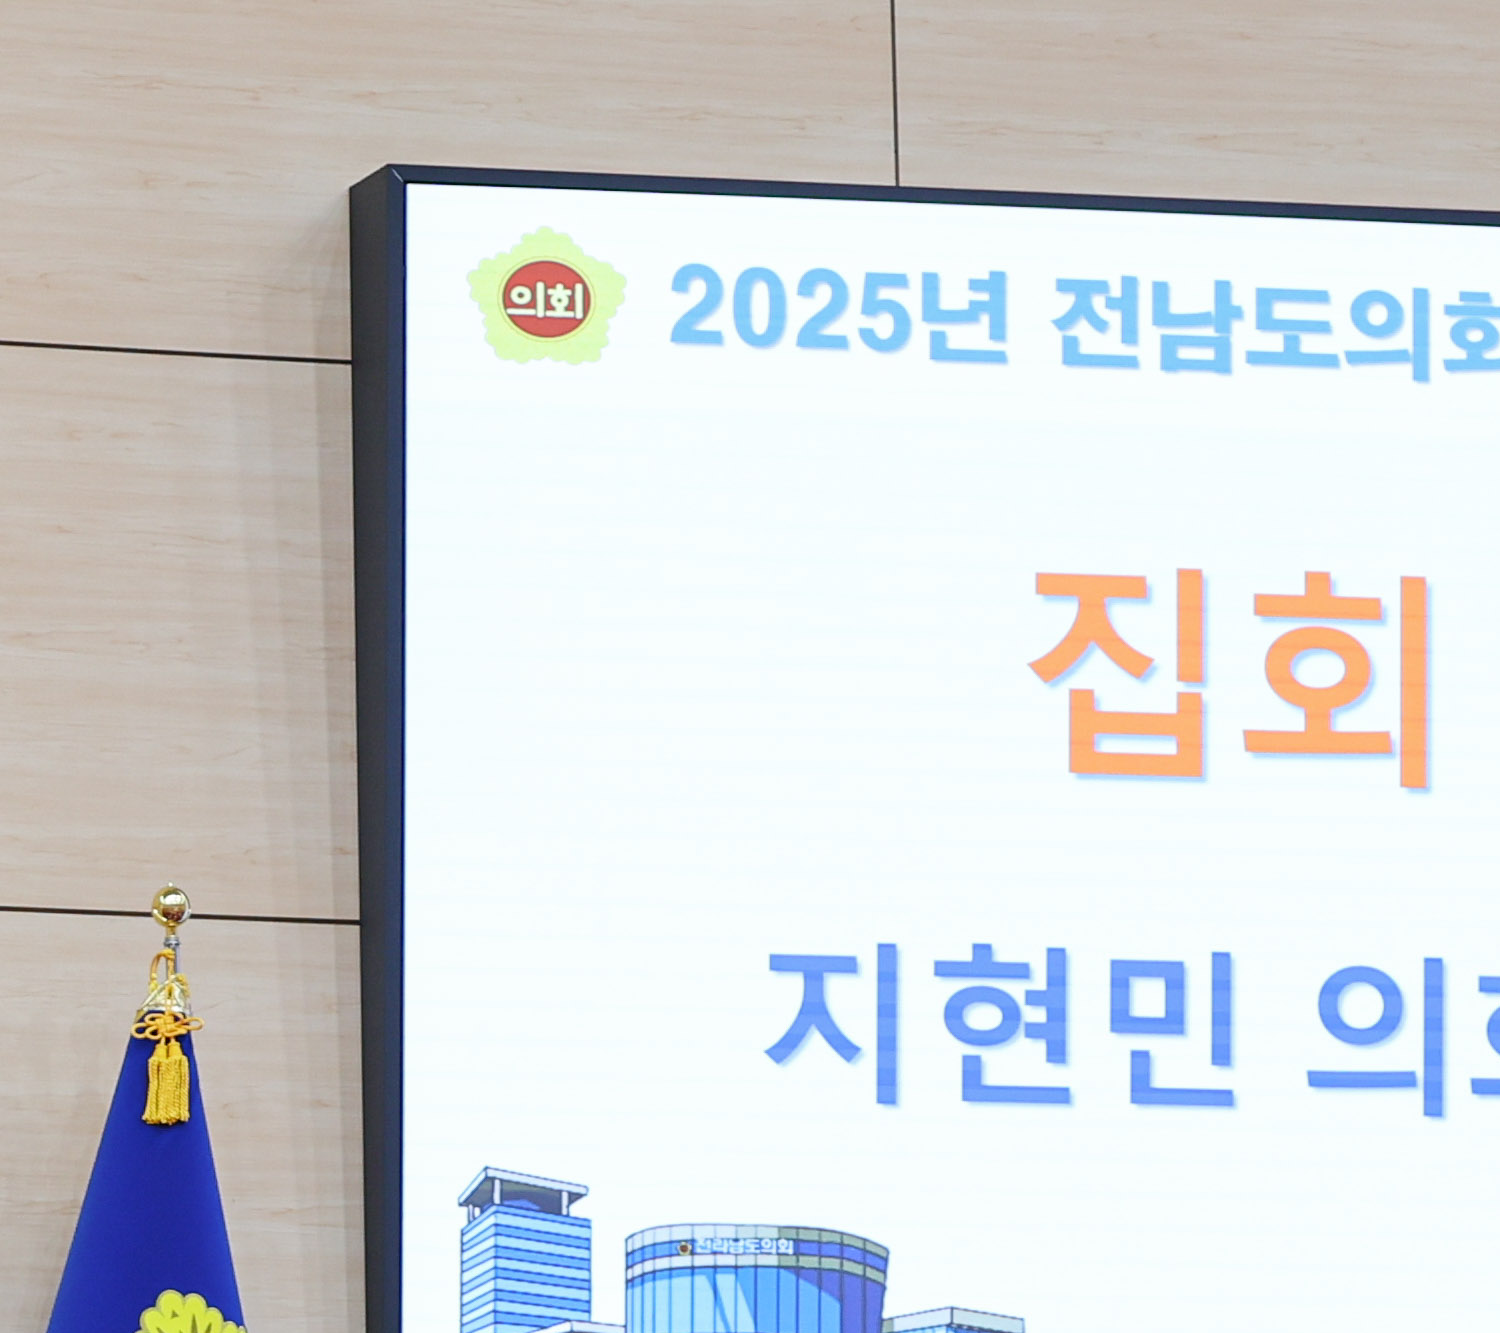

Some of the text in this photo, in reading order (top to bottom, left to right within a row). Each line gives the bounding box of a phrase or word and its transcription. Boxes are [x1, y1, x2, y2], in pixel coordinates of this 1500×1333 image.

[505, 280, 585, 320] 의회
[669, 262, 1010, 365] 2025년
[1026, 567, 1430, 790] 집회
[764, 942, 1236, 1109] 지현민
